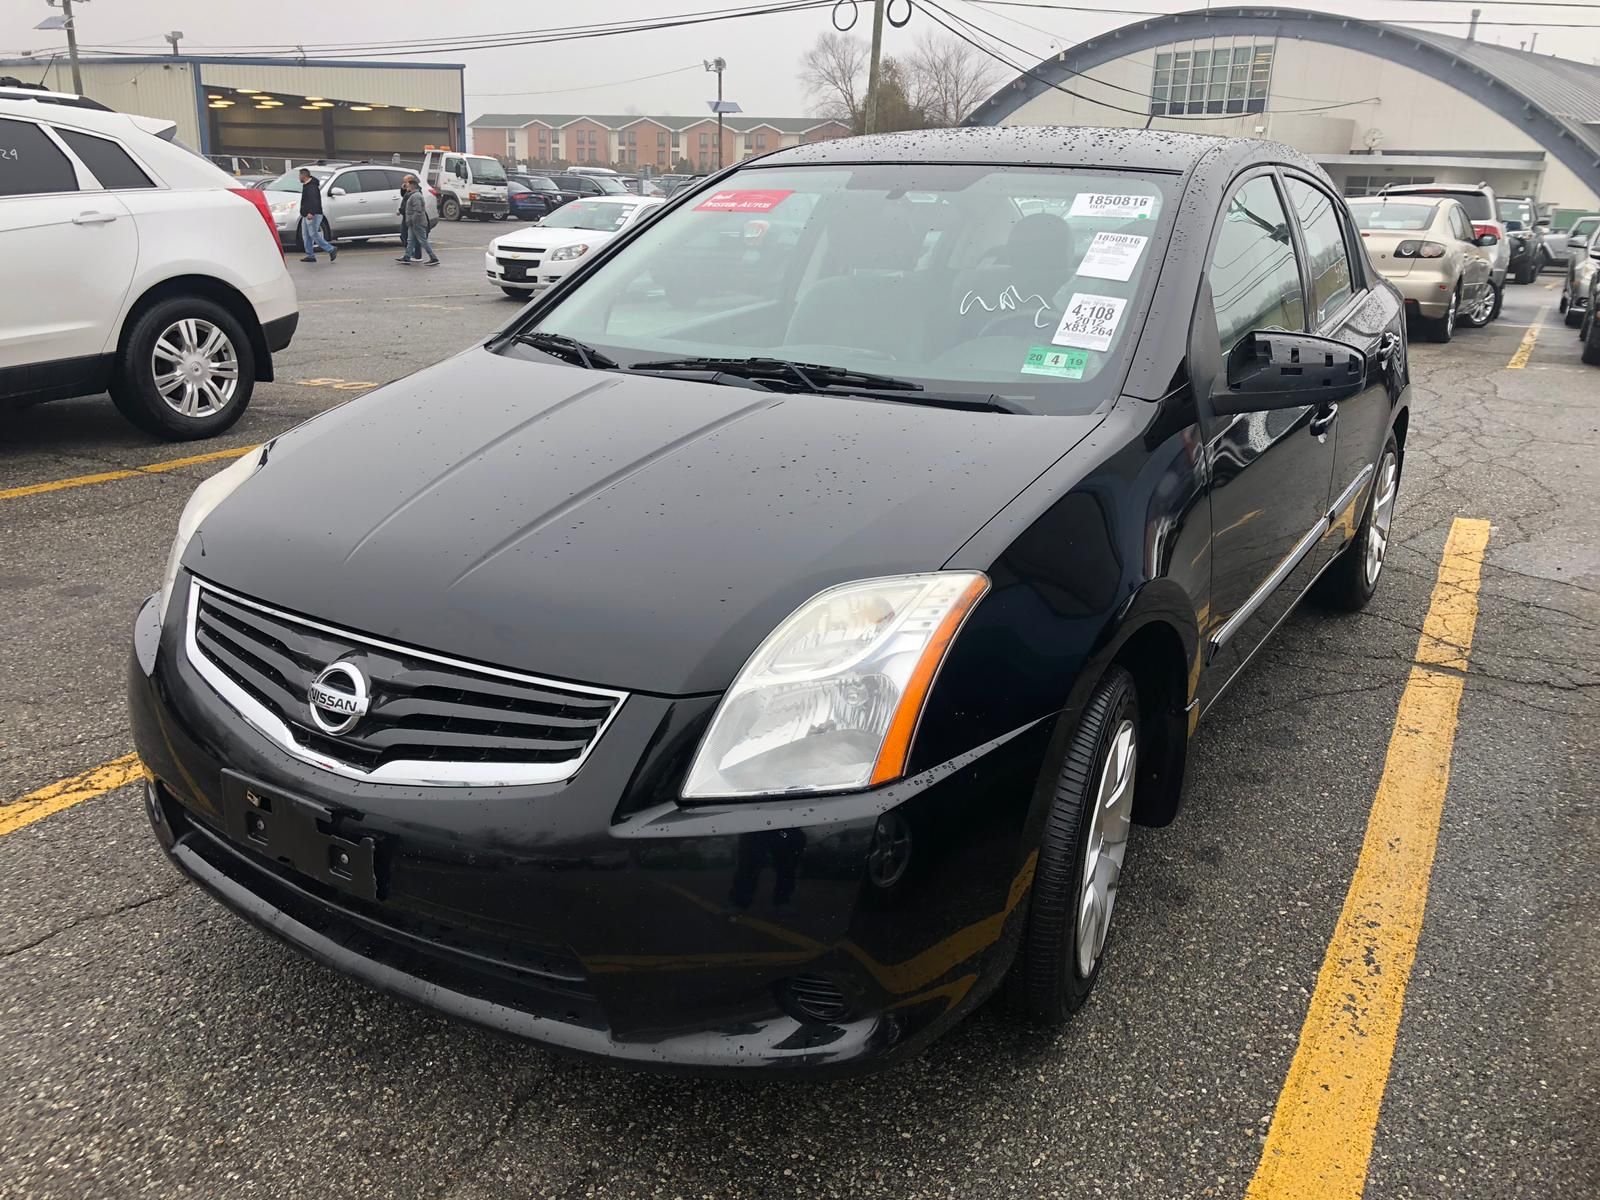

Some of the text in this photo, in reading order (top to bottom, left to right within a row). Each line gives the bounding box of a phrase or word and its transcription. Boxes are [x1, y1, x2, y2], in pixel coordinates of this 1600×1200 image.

[1089, 195, 1149, 207] 1850816
[1097, 234, 1142, 245] 1850816
[1072, 304, 1115, 321] 4:108
[1074, 316, 1105, 327] 2012
[1029, 353, 1084, 366] 20 4 19
[311, 688, 357, 712] NISSAN
